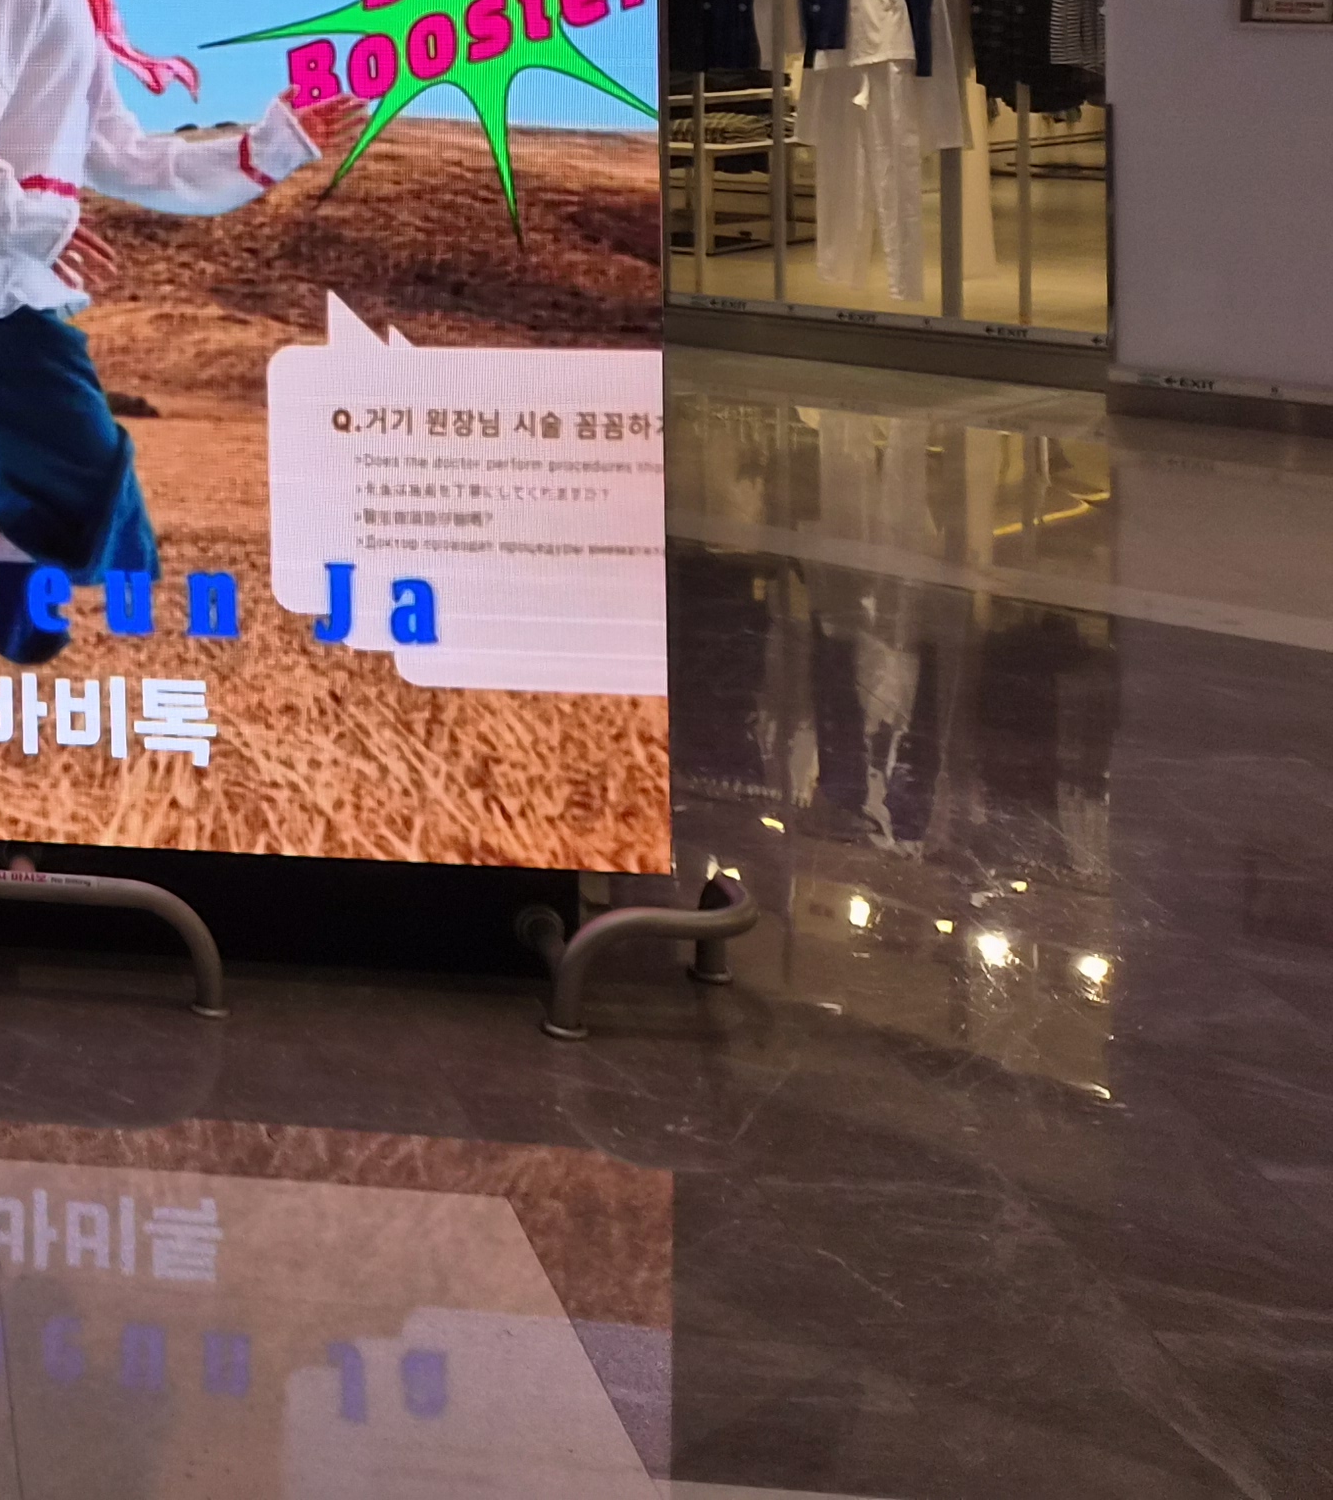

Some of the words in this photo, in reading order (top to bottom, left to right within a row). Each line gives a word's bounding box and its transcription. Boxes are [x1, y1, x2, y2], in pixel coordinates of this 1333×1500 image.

[331, 407, 413, 437] Q.거기
[425, 408, 500, 439] 원장님
[513, 410, 562, 440] 시술
[314, 562, 439, 645] Ja
